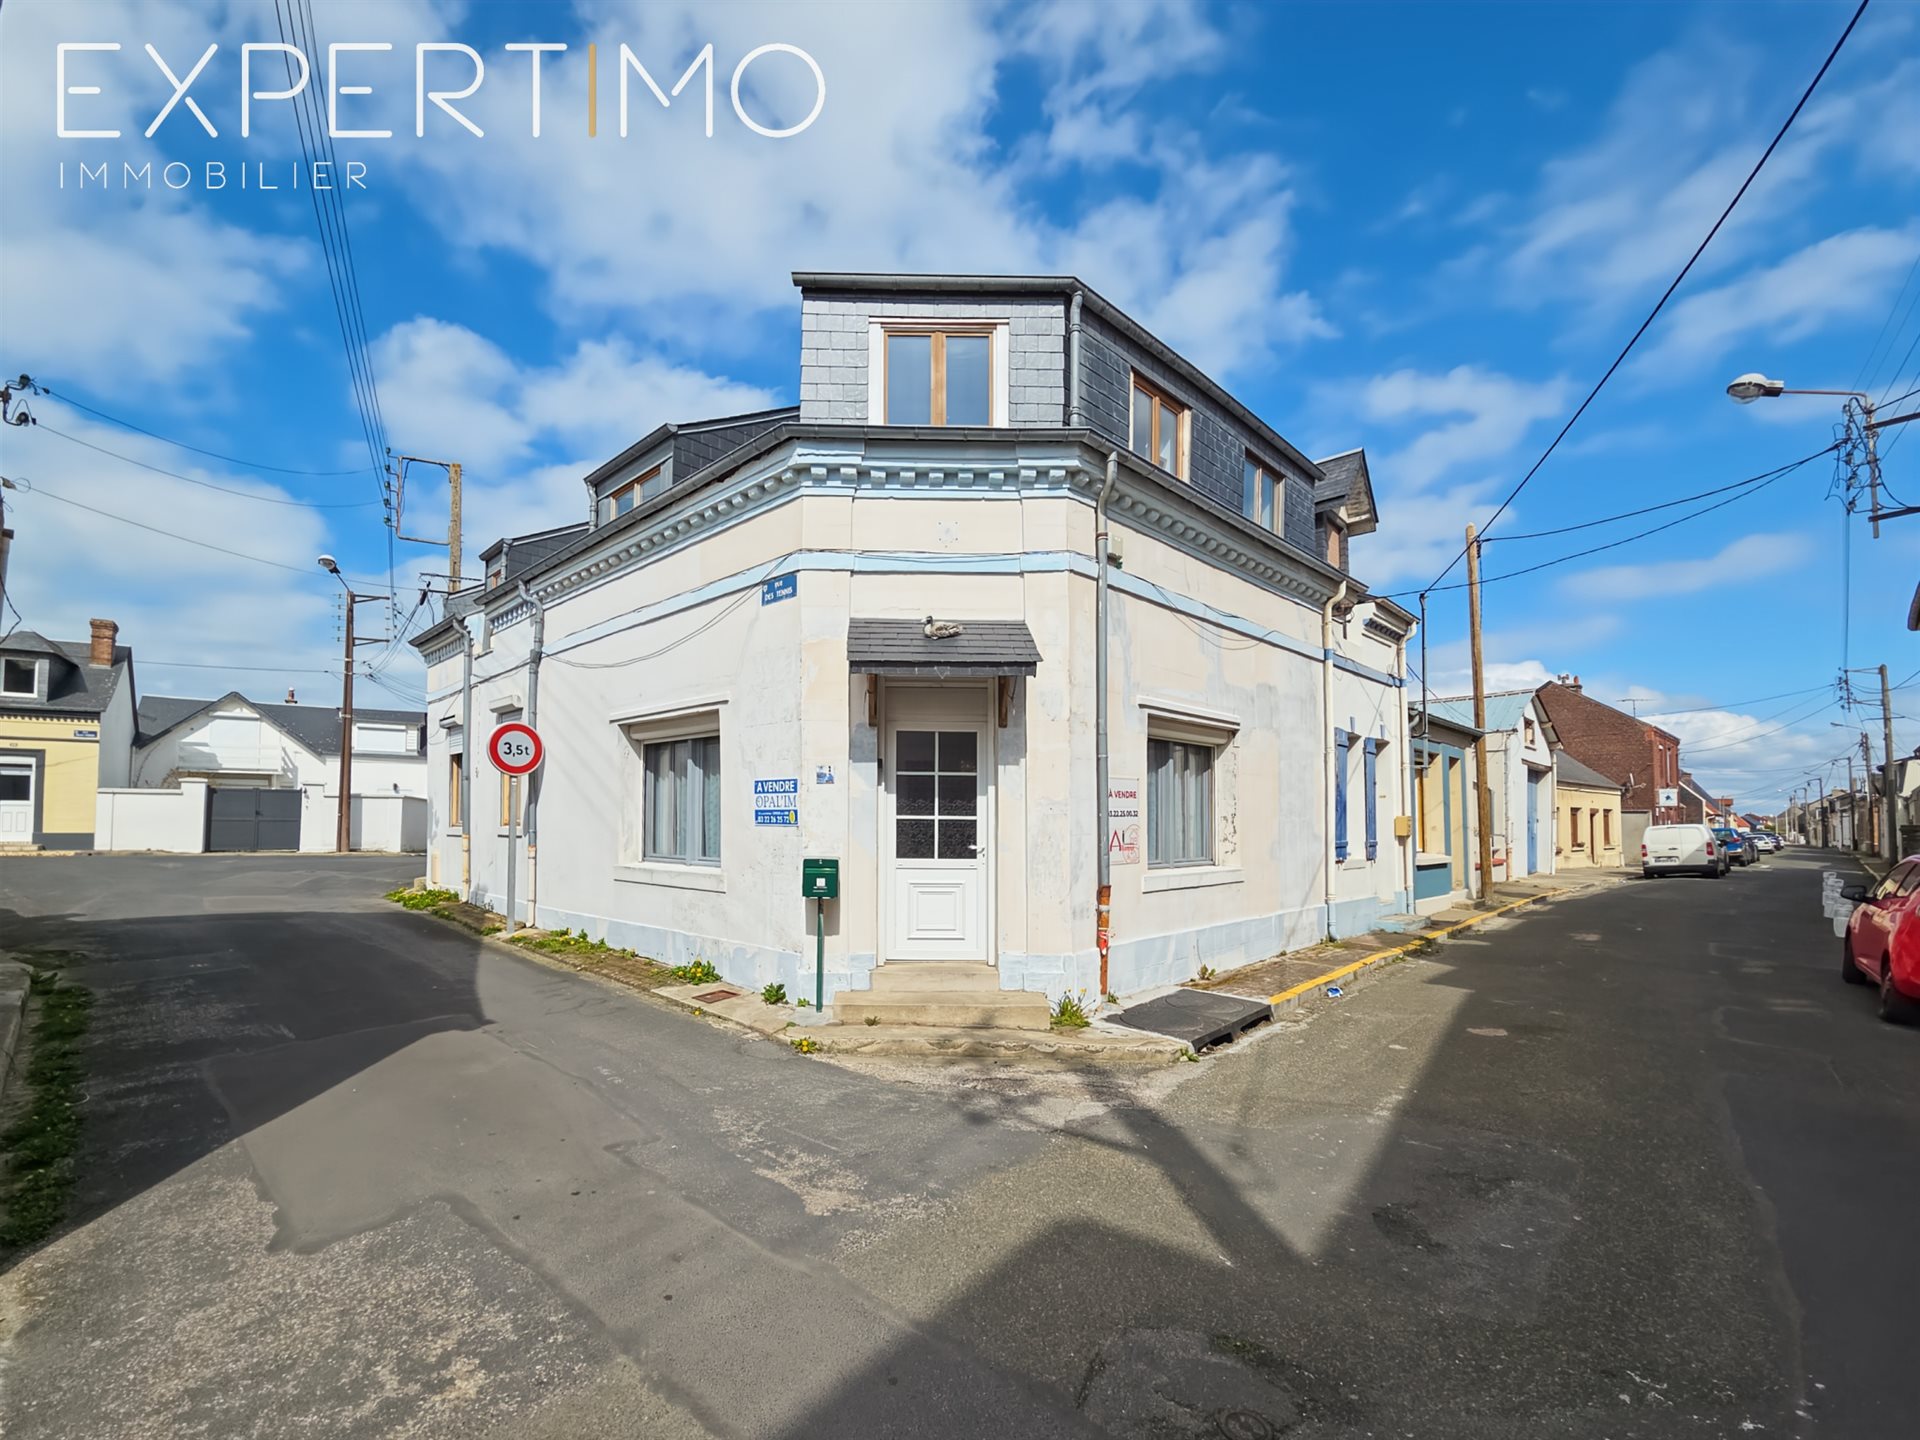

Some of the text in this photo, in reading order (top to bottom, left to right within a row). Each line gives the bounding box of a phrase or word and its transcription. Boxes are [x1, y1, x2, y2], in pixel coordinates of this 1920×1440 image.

[756, 781, 794, 792] A VENDRE
[1114, 790, 1136, 798] VENDRE
